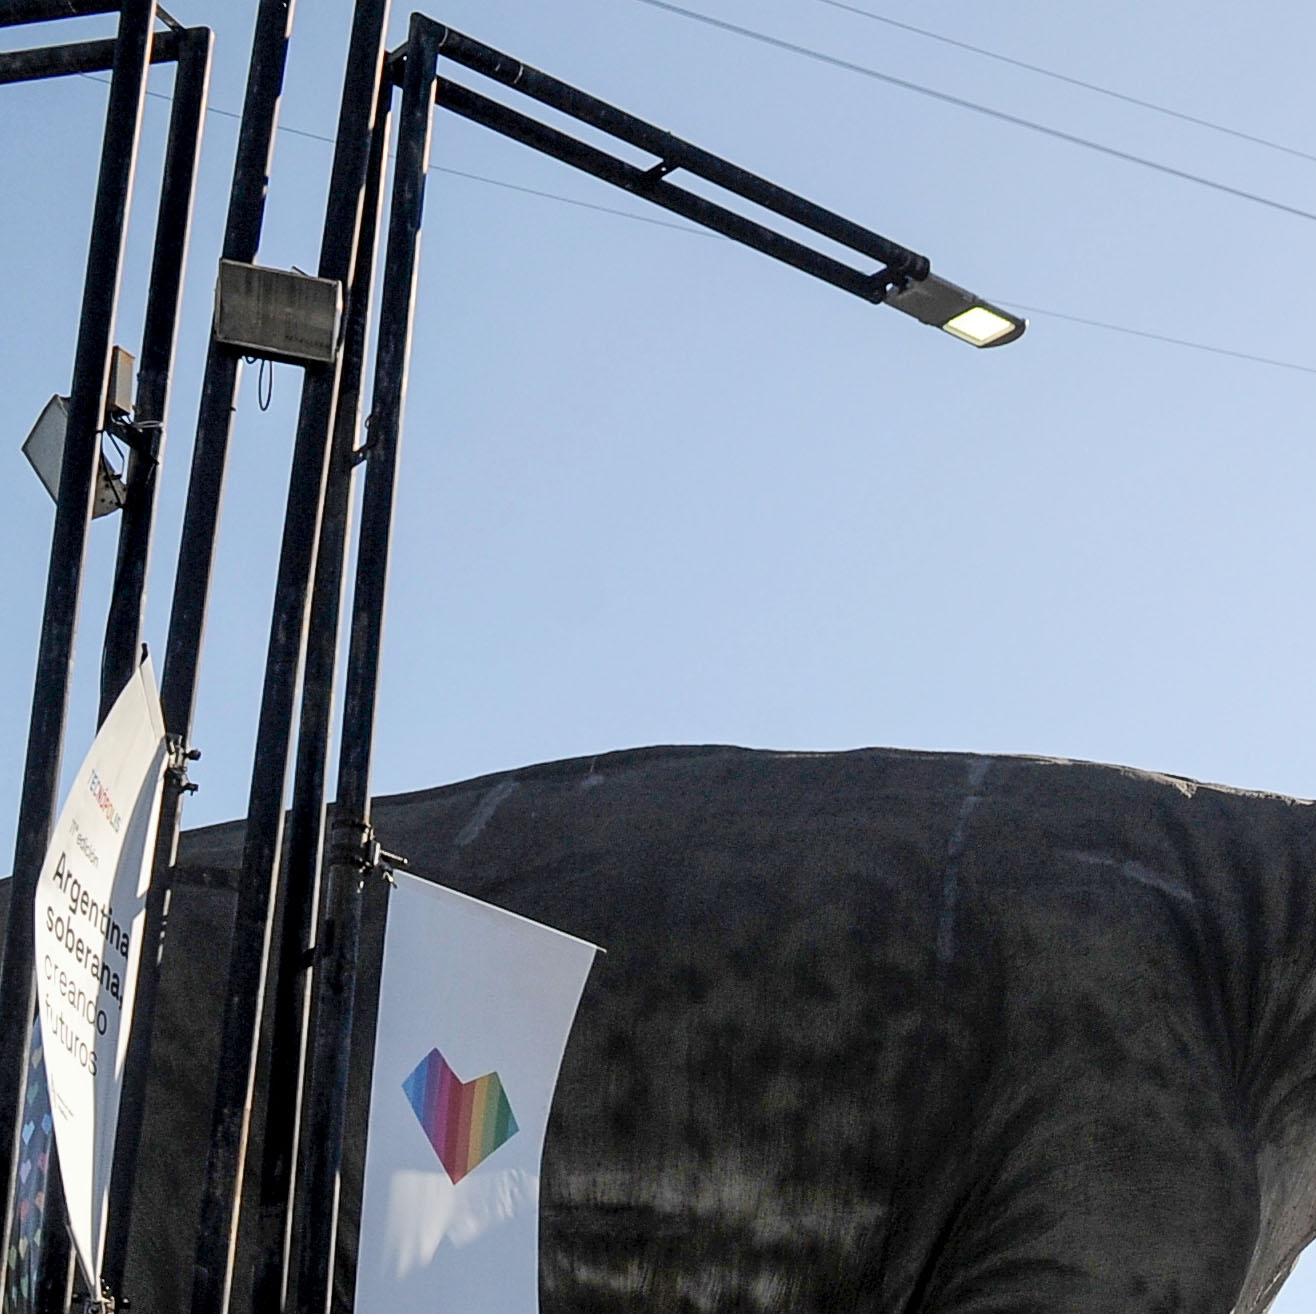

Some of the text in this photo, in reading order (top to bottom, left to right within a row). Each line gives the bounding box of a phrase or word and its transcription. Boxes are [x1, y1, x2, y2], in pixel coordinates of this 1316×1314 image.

[53, 851, 130, 960] Argentina
[44, 954, 107, 1036] creando
[46, 905, 124, 1010] soberana,
[44, 993, 98, 1077] futuros
